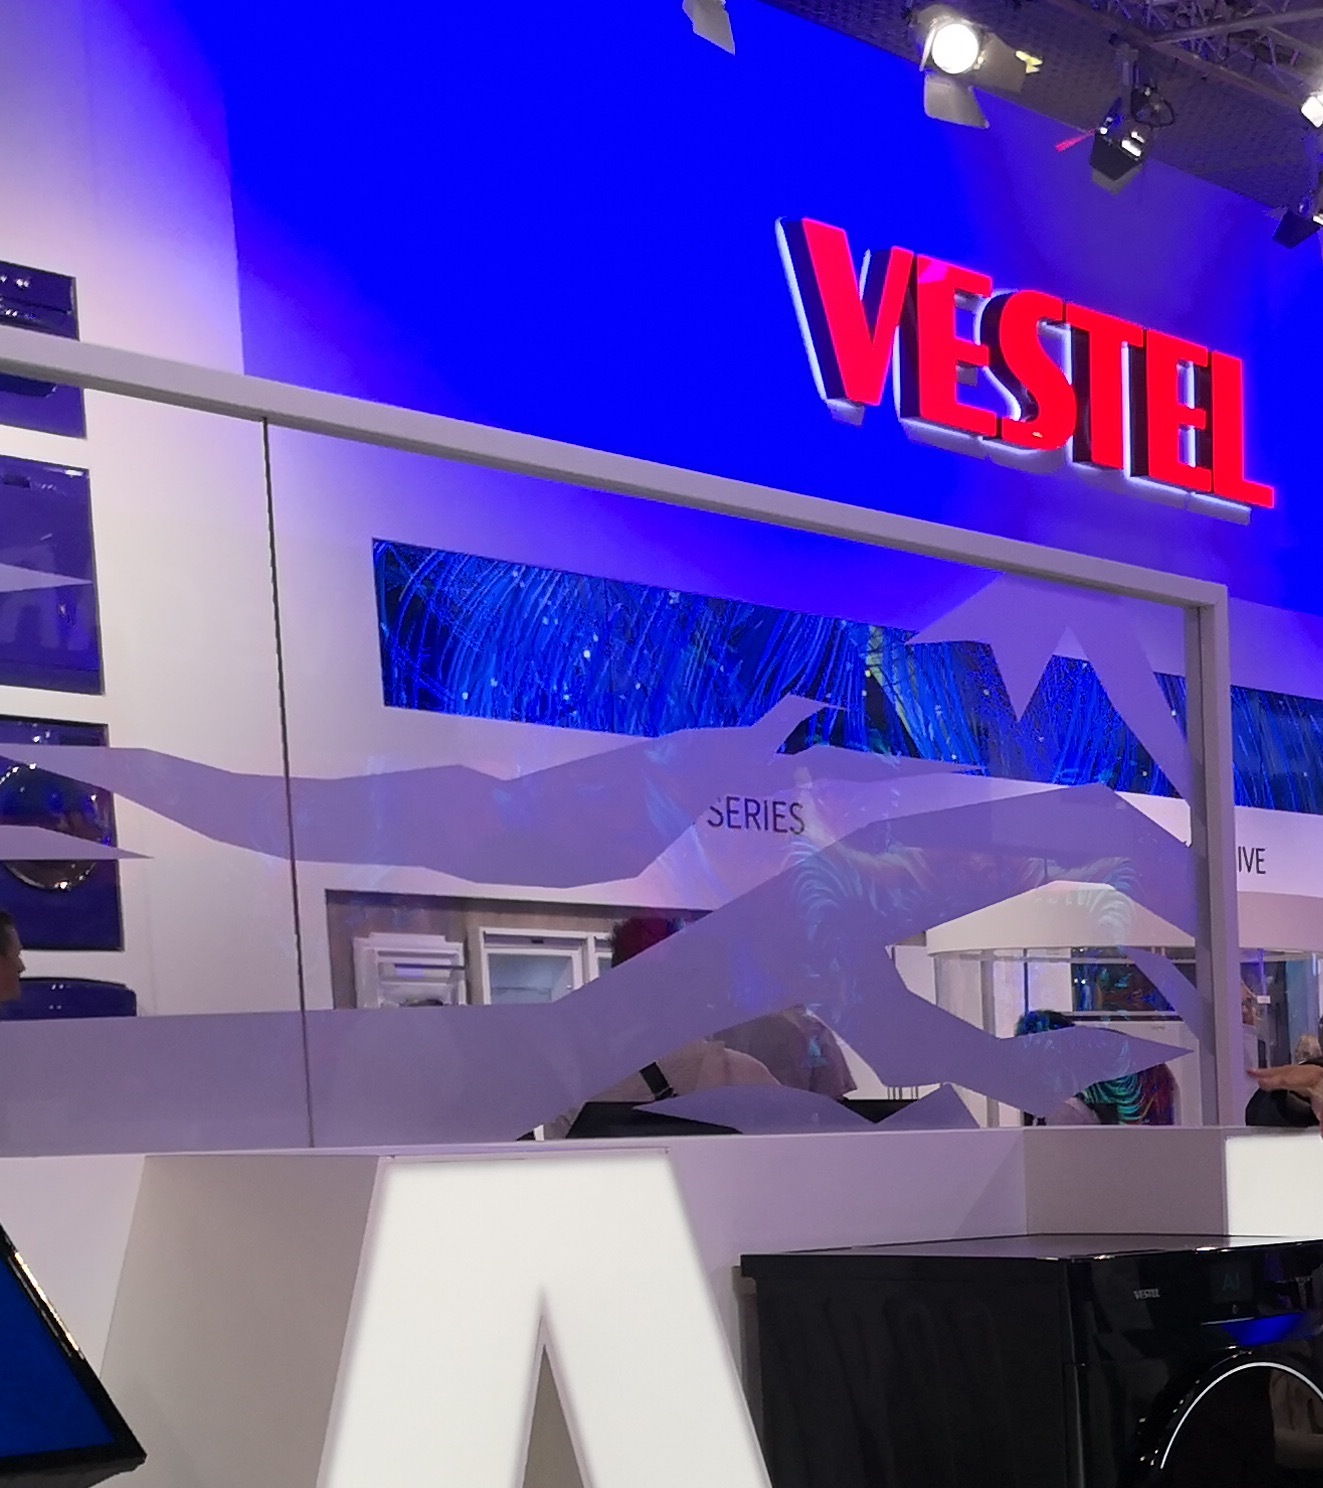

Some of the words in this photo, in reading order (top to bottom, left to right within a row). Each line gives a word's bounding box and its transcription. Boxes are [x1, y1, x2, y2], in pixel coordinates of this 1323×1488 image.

[782, 216, 1276, 514] VESTEL
[707, 796, 805, 835] SERIES
[1238, 846, 1266, 874] IVE
